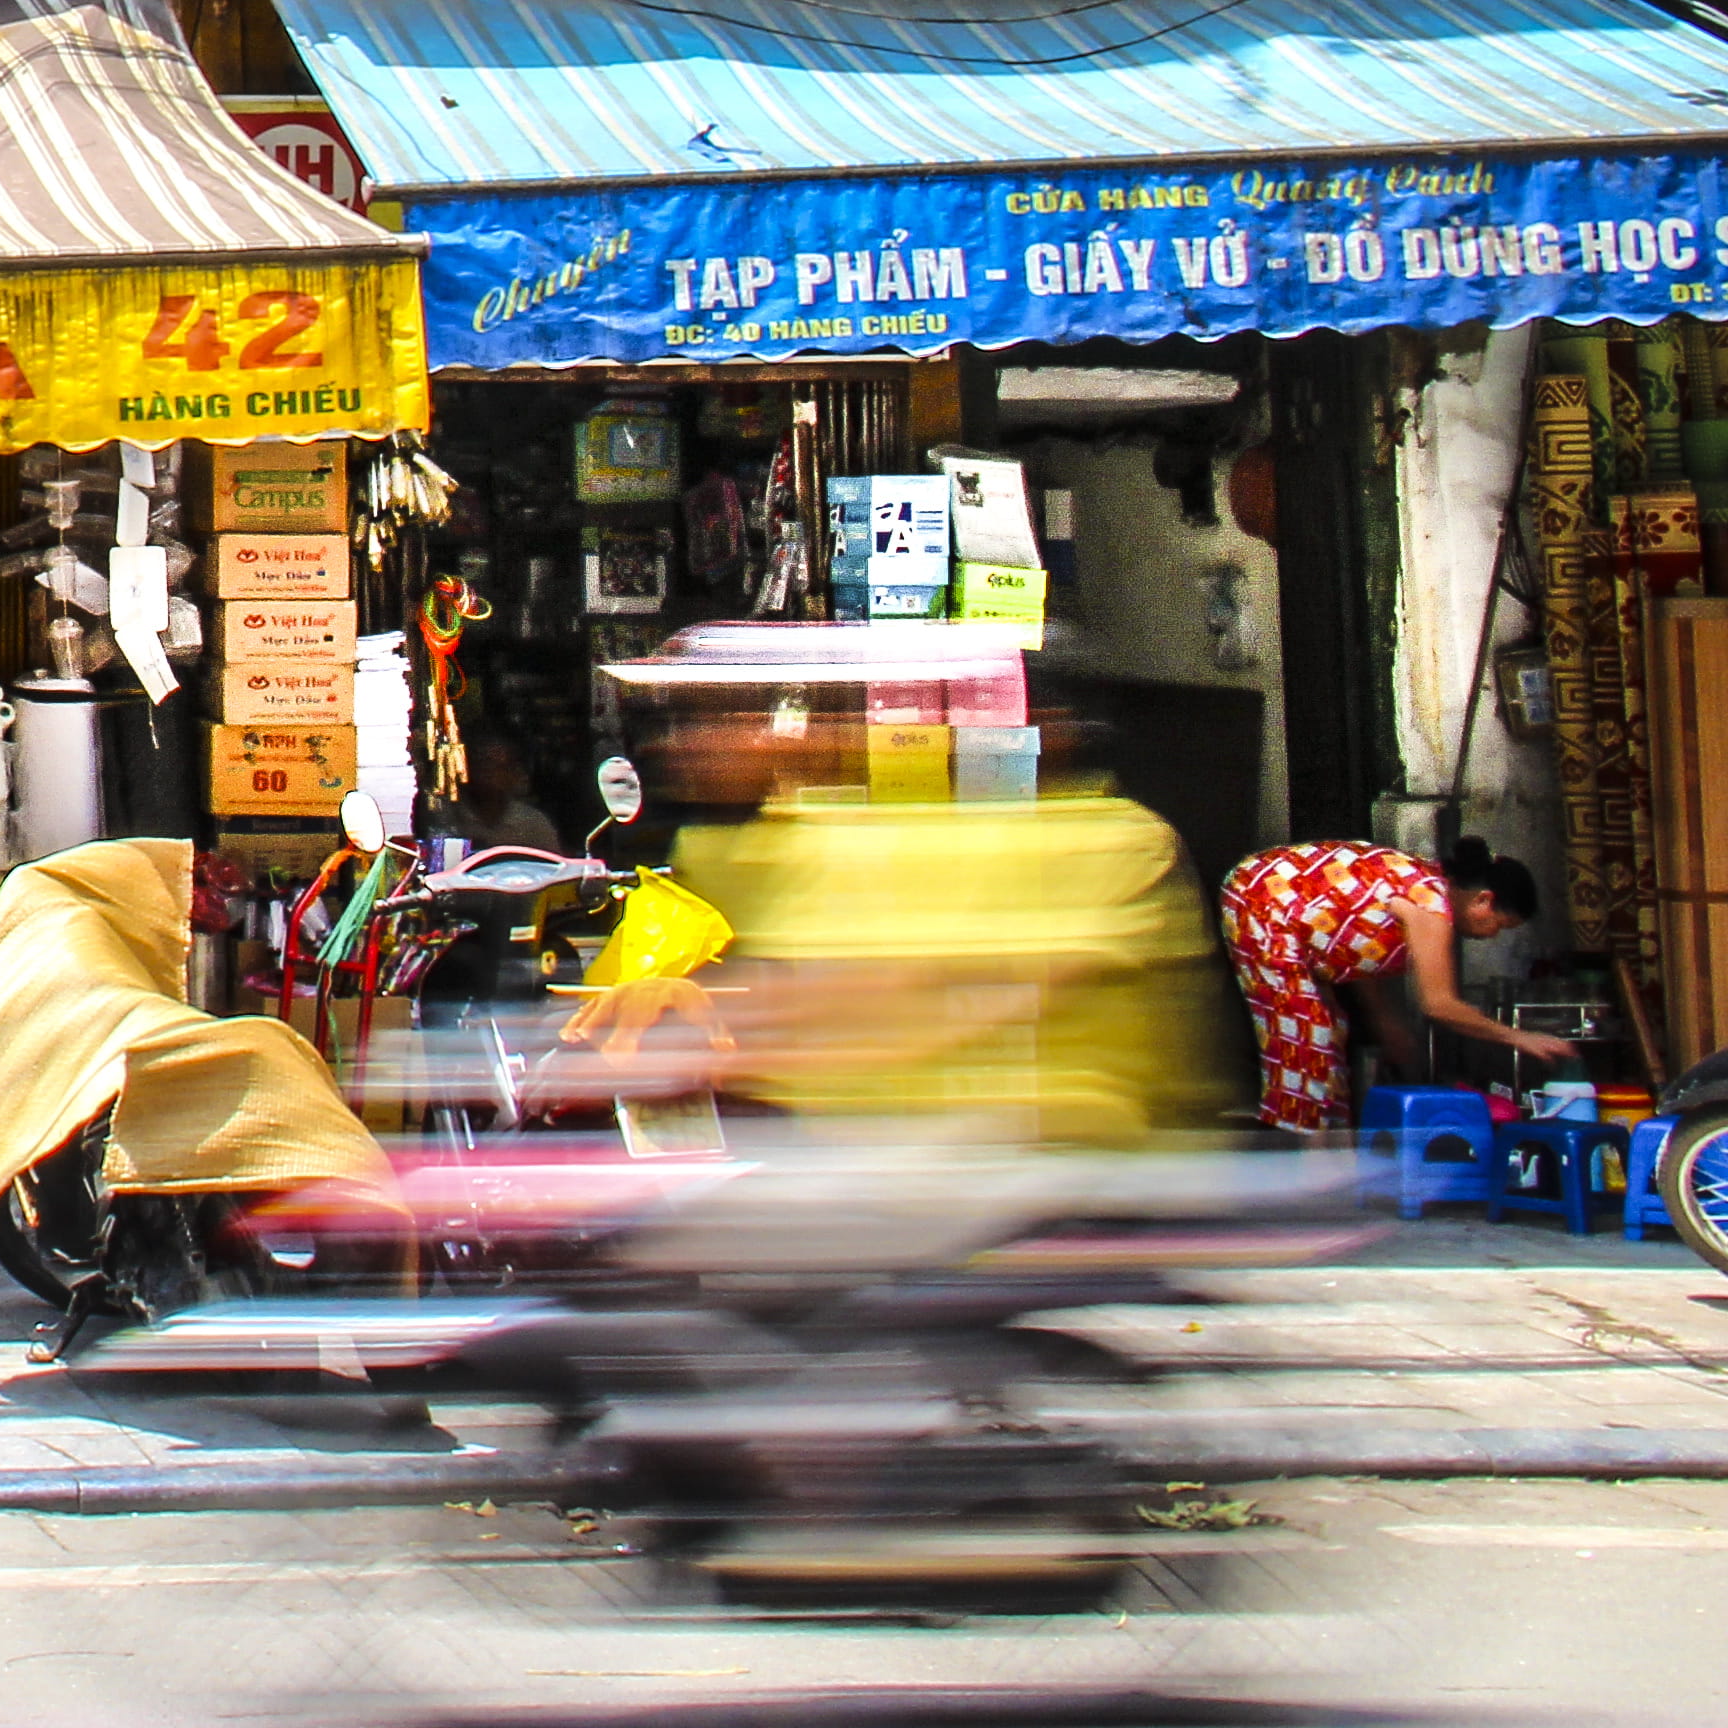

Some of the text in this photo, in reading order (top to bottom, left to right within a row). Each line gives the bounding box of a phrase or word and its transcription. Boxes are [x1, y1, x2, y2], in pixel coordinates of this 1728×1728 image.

[1005, 183, 1087, 215] CỬA
[1097, 183, 1209, 211] HÀNG
[472, 228, 632, 334] Chuyên
[664, 256, 776, 322] TẠP
[795, 228, 968, 306] PHẨM
[984, 268, 1009, 281] -
[1024, 221, 1156, 296] GIẤY
[1171, 217, 1252, 290] VỞ
[1304, 212, 1387, 284] ĐỒ
[1401, 215, 1564, 280] DÙNG
[1577, 217, 1698, 283] HỌC
[141, 290, 323, 372] 42
[723, 324, 761, 343] 40
[769, 316, 853, 341] HÀNG
[862, 308, 948, 336] CHIẾU
[118, 381, 362, 422] HÀNG CHIẾU
[234, 486, 327, 514] Campus
[251, 769, 288, 793] 60
